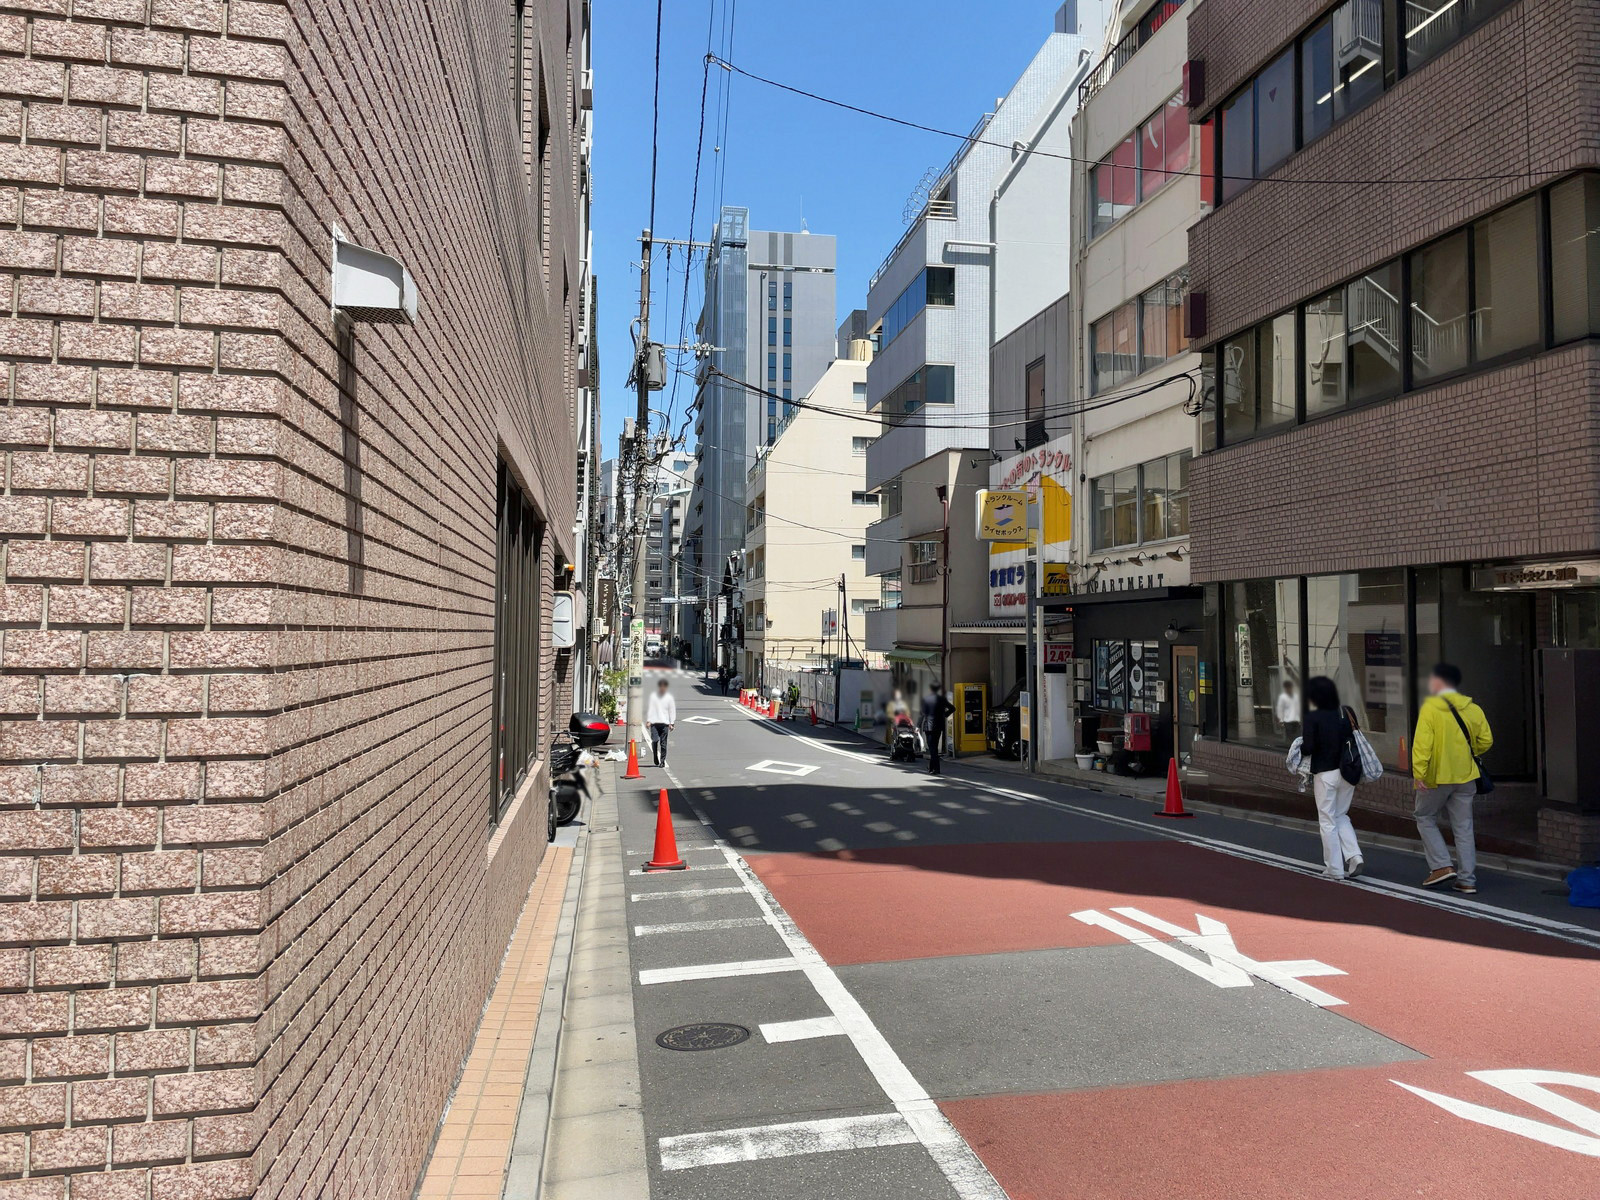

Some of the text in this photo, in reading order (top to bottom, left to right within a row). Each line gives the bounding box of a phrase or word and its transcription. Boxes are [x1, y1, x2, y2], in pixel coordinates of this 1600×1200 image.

[985, 495, 1023, 506] トランクルーム
[984, 525, 1023, 535] ライゼボックス
[1046, 573, 1070, 585] Time
[1086, 573, 1164, 594] APARTMENT
